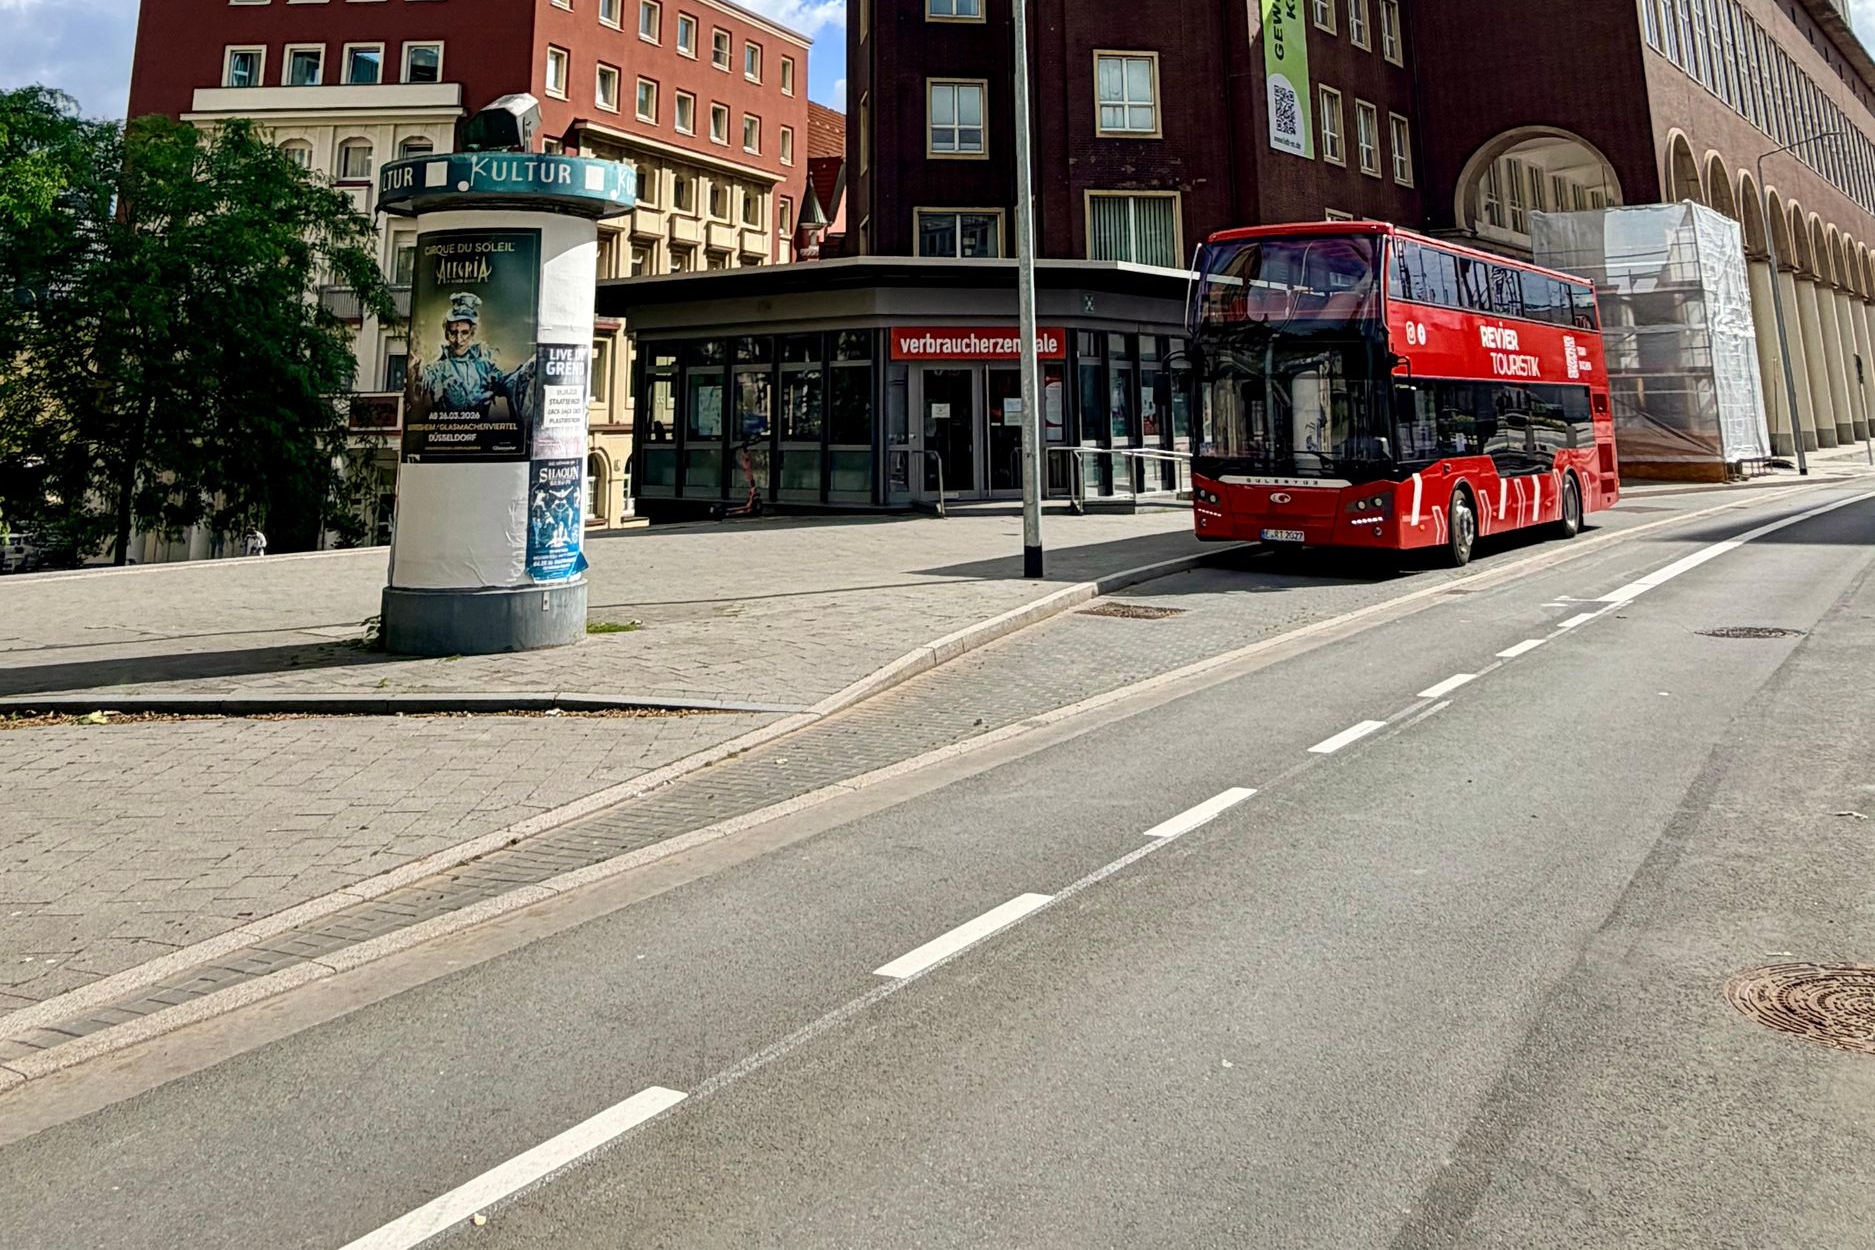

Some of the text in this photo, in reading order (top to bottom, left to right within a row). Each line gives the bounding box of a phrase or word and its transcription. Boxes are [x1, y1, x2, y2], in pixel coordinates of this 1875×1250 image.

[382, 166, 413, 192] LTUR
[470, 155, 571, 187] KULTUR
[424, 242, 515, 257] CIRQUE DU SOLEIL
[900, 333, 1058, 354] verbraucherzenale
[1479, 321, 1520, 351] REVIER
[549, 348, 573, 361] LIVE
[1490, 352, 1541, 377] TOURISTIK
[428, 432, 477, 442] DÜSSELDORF
